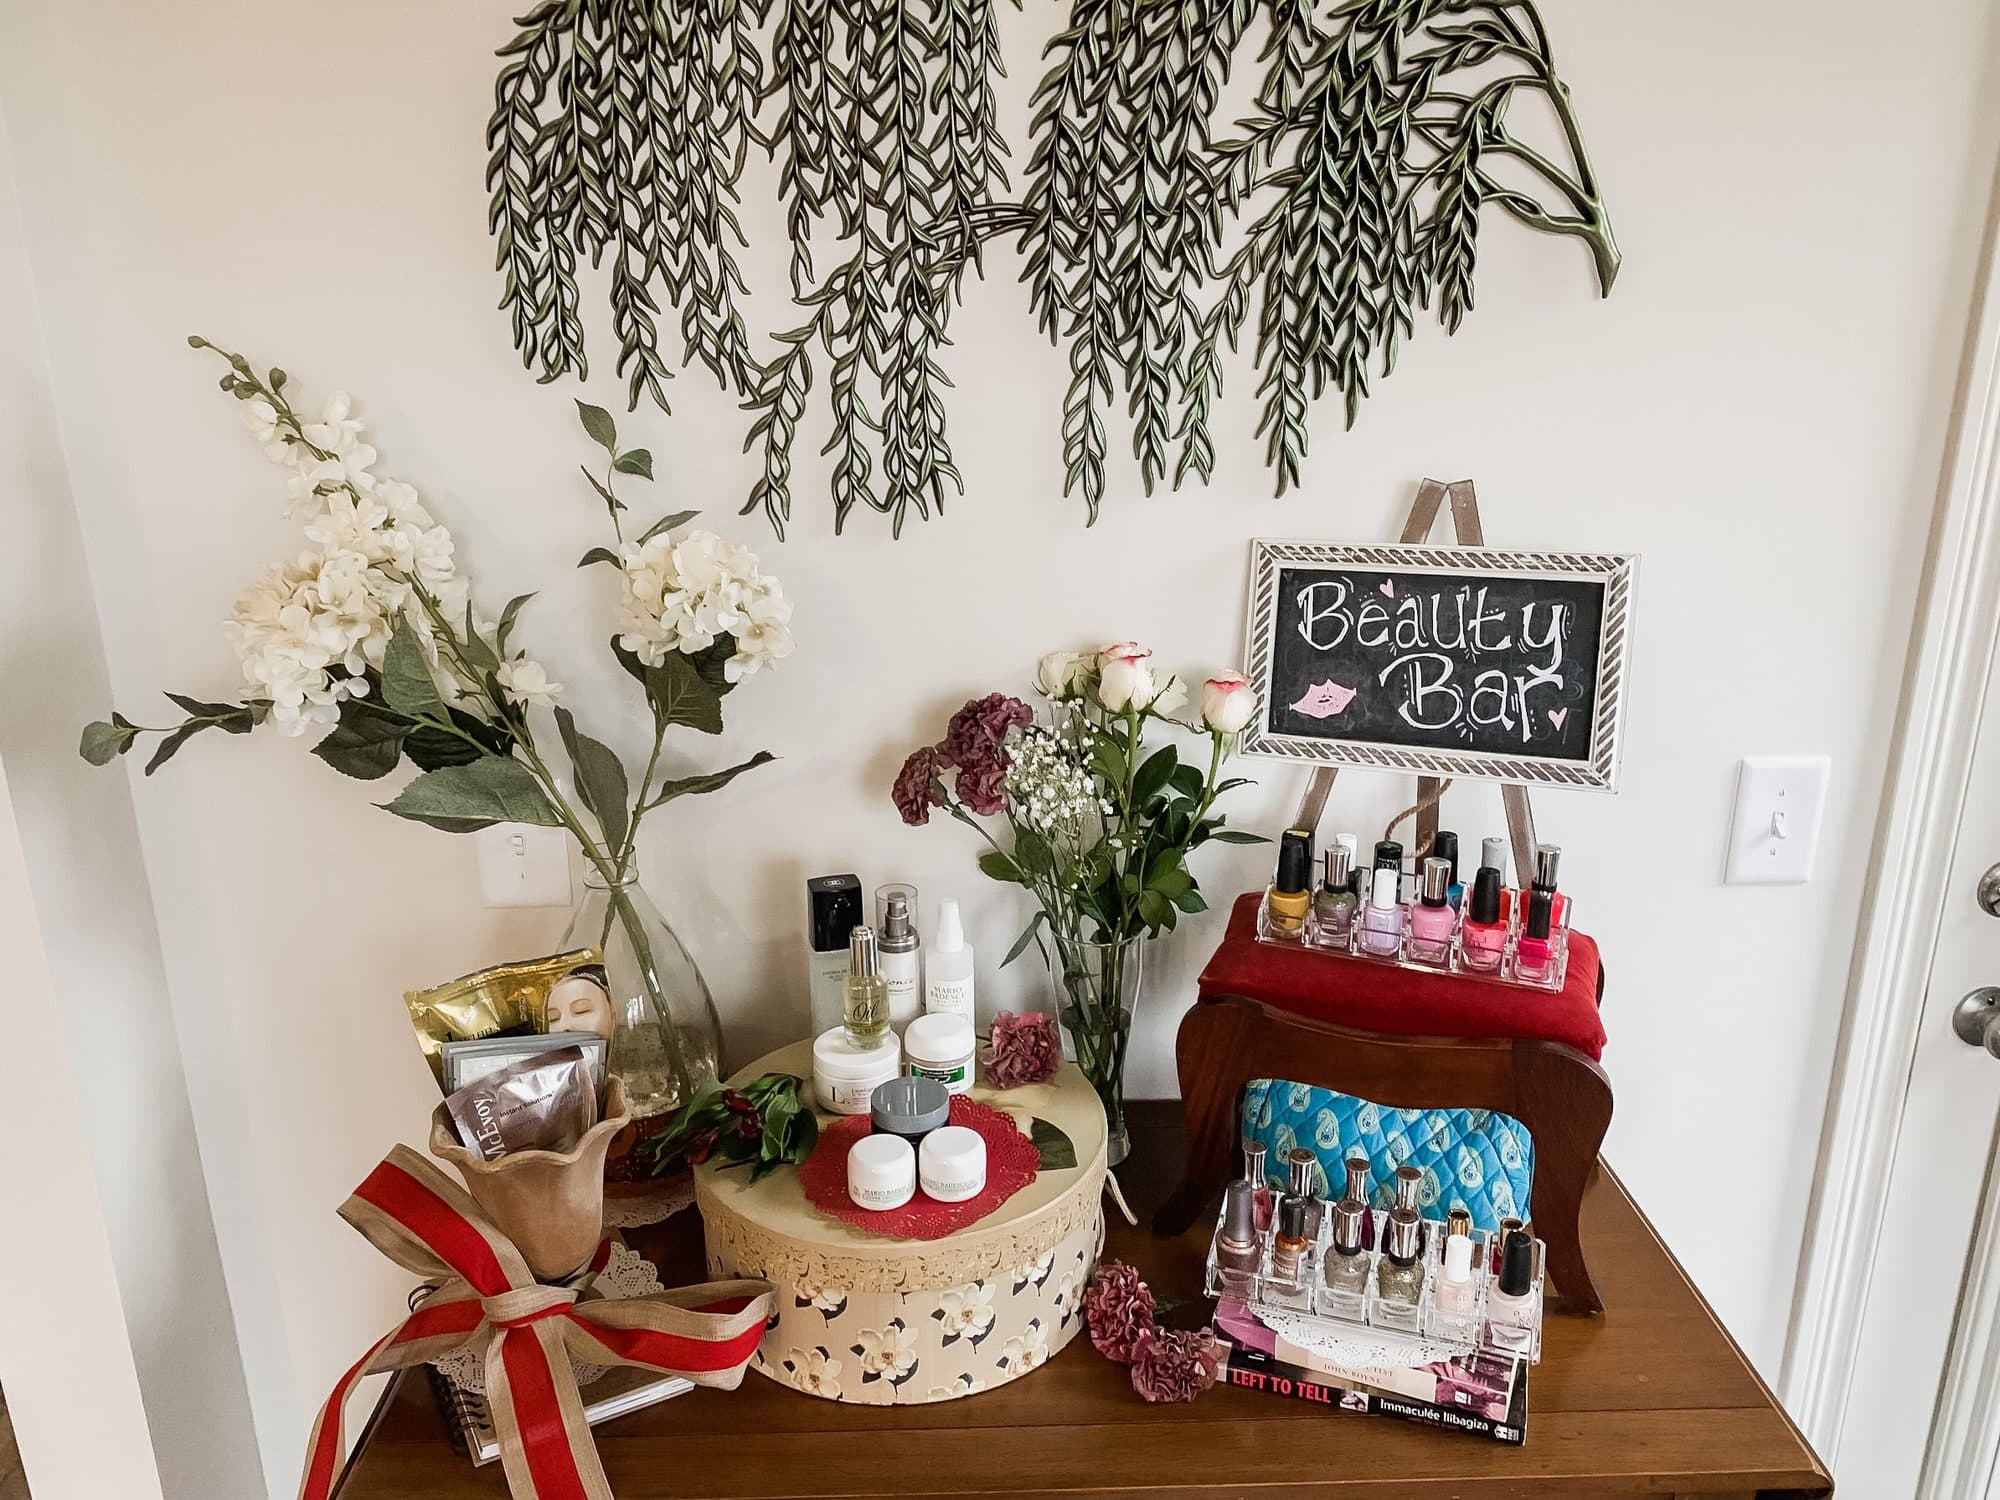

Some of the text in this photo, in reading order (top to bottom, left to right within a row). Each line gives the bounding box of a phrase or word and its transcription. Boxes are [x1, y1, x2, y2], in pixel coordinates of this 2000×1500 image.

[1297, 581, 1565, 678] Beauty
[1379, 653, 1565, 743] Bar
[934, 986, 962, 994] MARIO
[853, 1000, 881, 1021] Oil
[500, 1105, 523, 1118] Instant
[1233, 1368, 1331, 1403] LEFT TO TELL
[1324, 1364, 1347, 1375] JOHN
[1351, 1371, 1382, 1384] BOYNE
[1380, 1398, 1440, 1421] Immaculée
[1443, 1411, 1489, 1431] Ilibagiza
